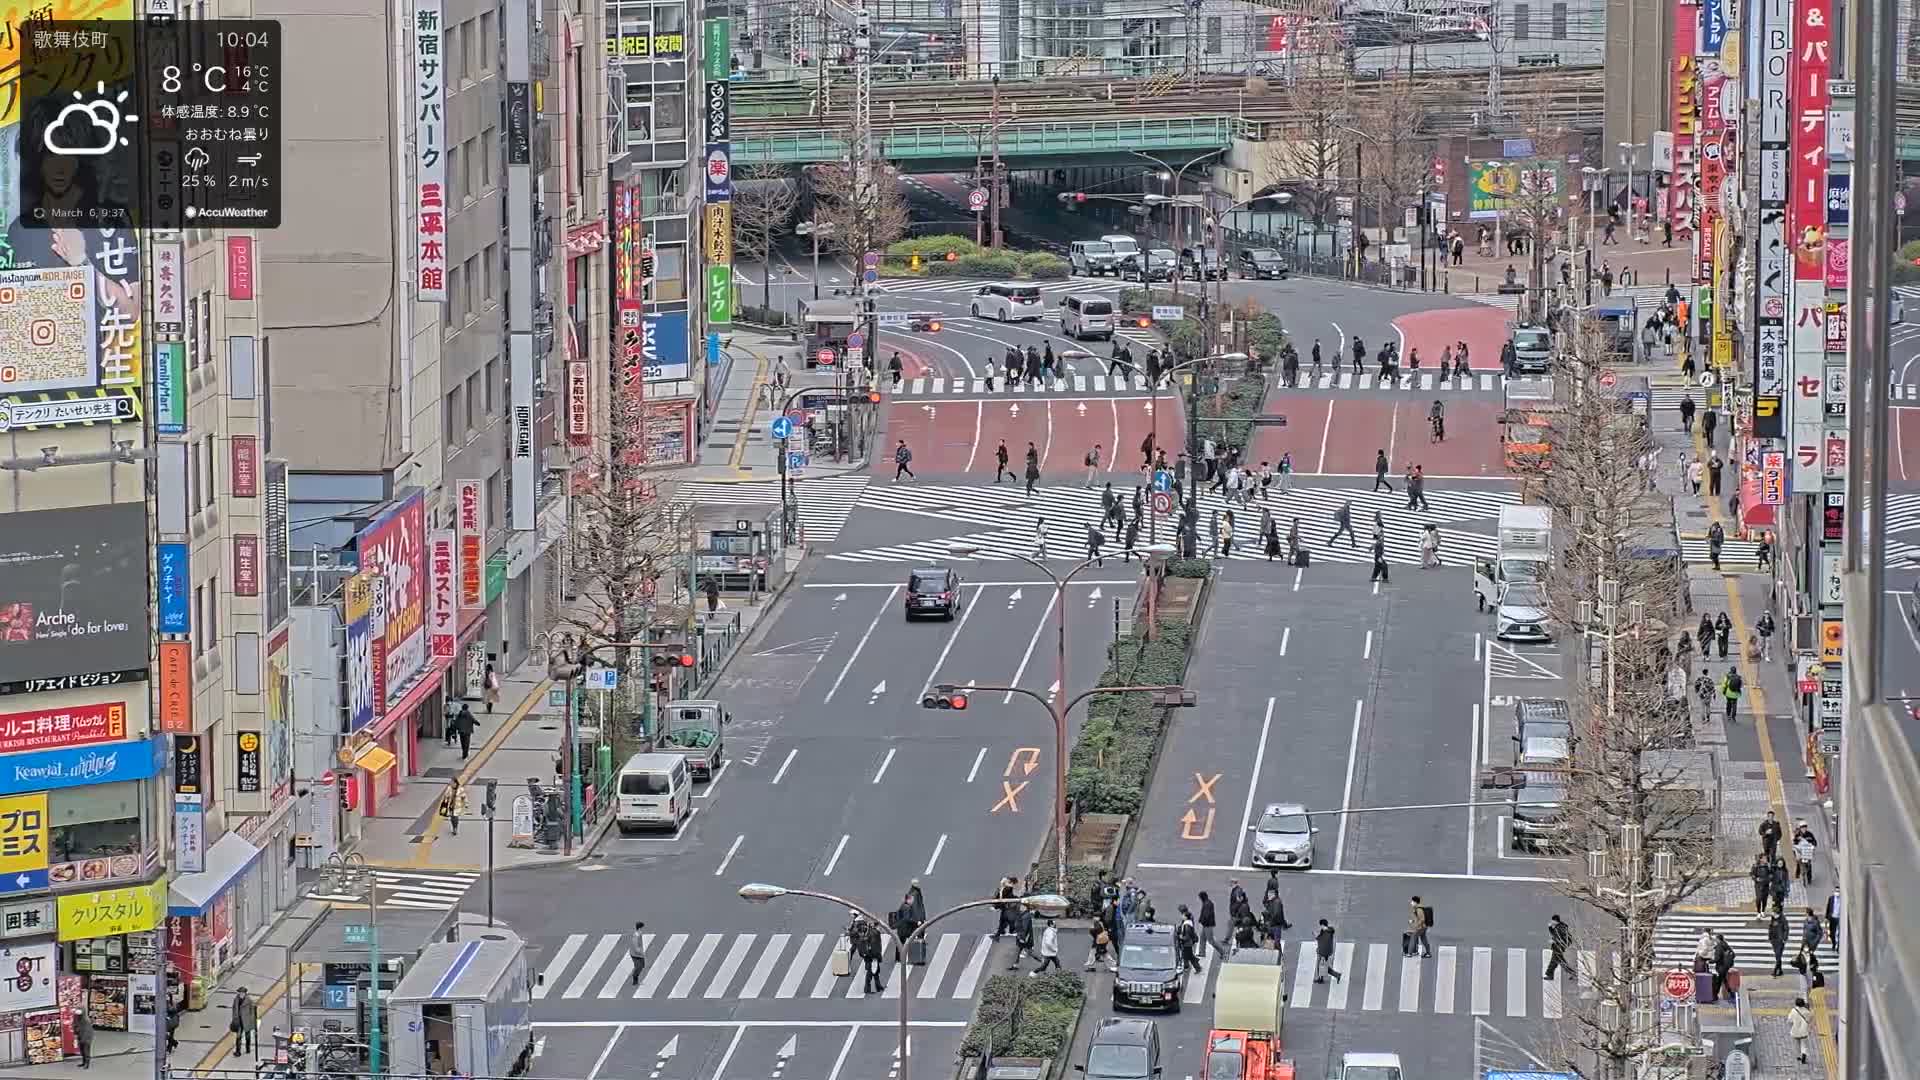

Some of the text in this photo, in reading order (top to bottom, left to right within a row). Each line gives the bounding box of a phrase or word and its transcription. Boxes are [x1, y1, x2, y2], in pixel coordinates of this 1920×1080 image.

[654, 35, 683, 53] 夜間
[417, 10, 440, 169] 新宿サンパーク
[420, 183, 443, 290] 三平本館
[713, 207, 724, 261] 肉汁水餃子
[712, 275, 725, 312] レイク
[159, 322, 177, 333] 3F
[1762, 329, 1775, 381] 大衆酒場
[160, 353, 170, 413] FamilyMart
[1796, 307, 1823, 467] パセラ
[463, 485, 474, 529] GAME
[1831, 496, 1842, 505] 3F
[434, 541, 450, 627] 三平ストア
[36, 609, 76, 626] Arche
[87, 622, 102, 634] for
[25, 672, 121, 692] リアエイドビジョン
[1, 809, 41, 834] プロ
[2, 834, 41, 857] ミス
[6, 910, 41, 930] 囲碁
[72, 901, 144, 925] クリスタル
[328, 990, 345, 1002] 12
